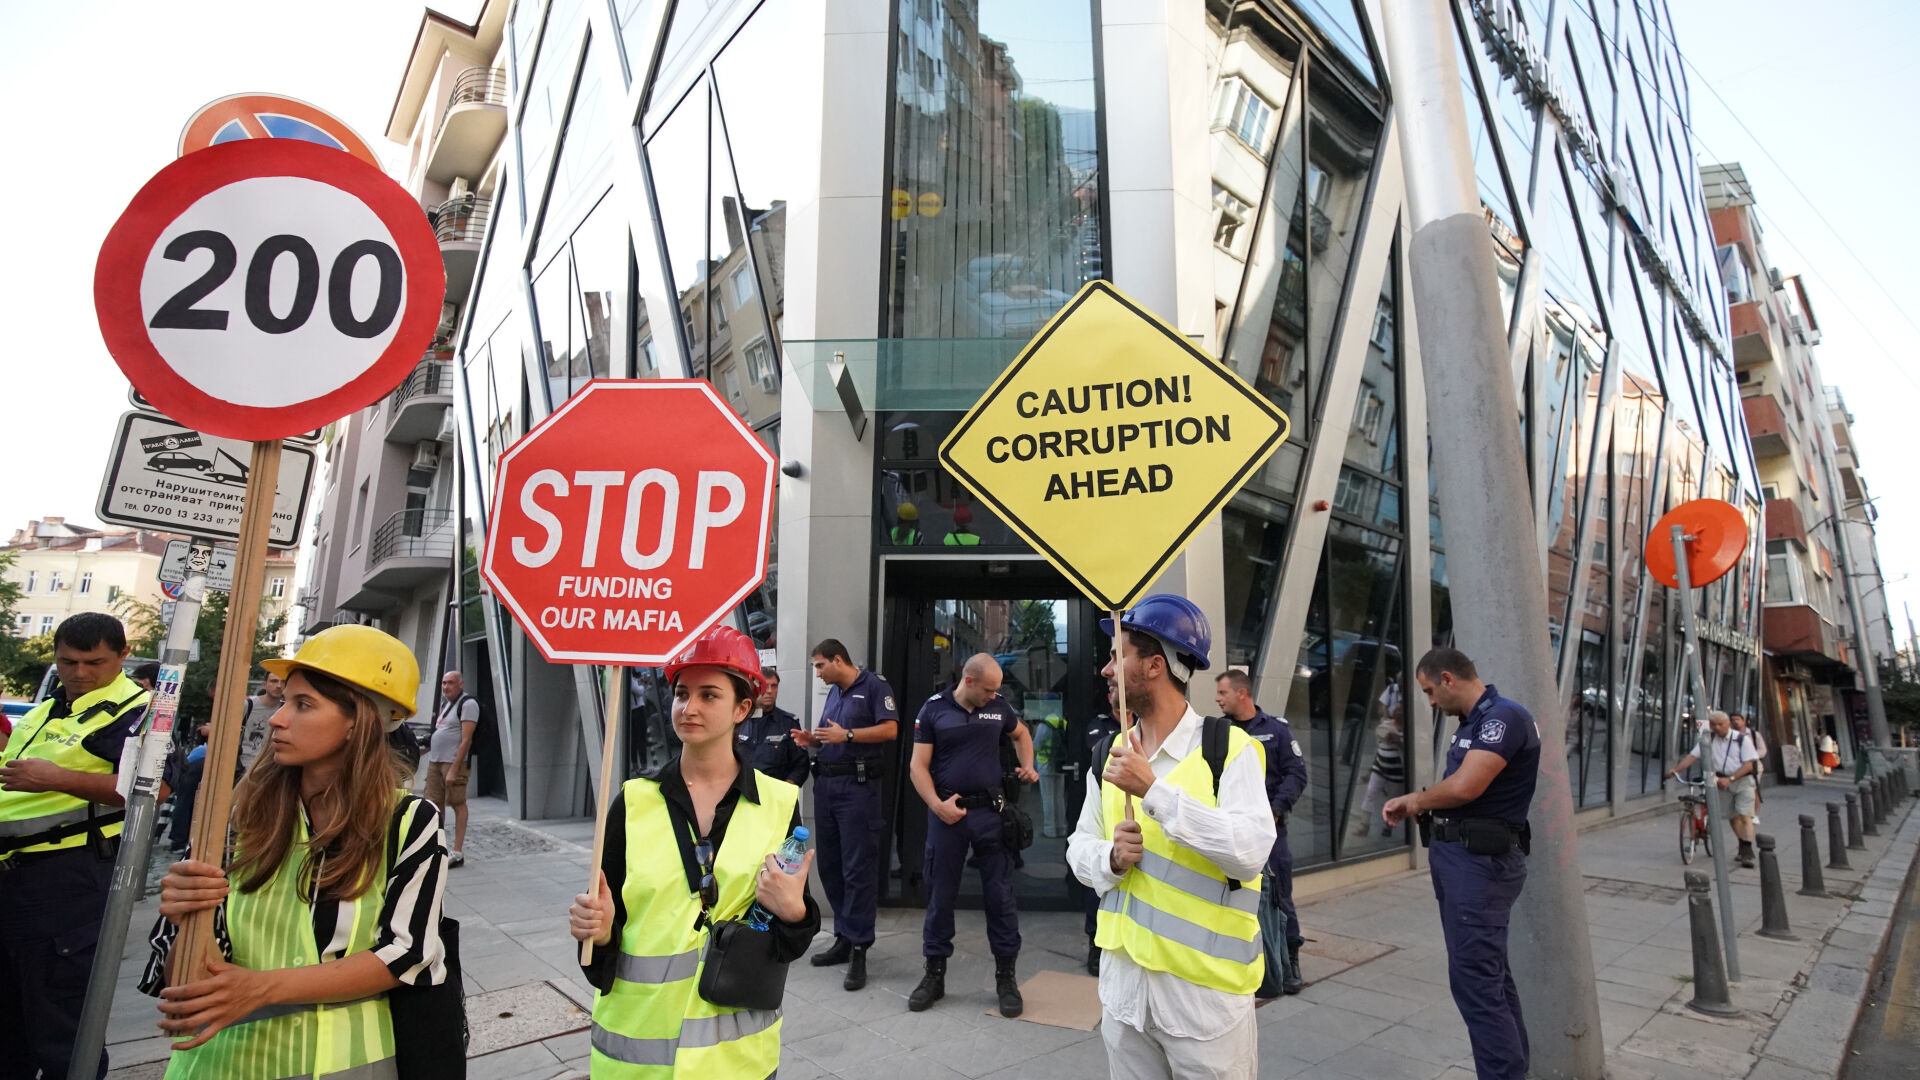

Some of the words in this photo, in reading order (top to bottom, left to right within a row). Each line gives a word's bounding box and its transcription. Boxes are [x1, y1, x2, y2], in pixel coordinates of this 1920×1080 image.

[149, 230, 403, 338] 200
[1016, 374, 1192, 419] CAUTION!
[986, 414, 1232, 464] CORRUPTION
[120, 485, 204, 506] отстраняват
[155, 479, 246, 503] Нарушителите
[1043, 463, 1173, 502] AHEAD
[143, 504, 173, 516] 0700
[177, 509, 188, 518] 13
[193, 512, 213, 523] 233
[511, 468, 746, 571] STOP
[558, 575, 673, 600] FUNDING
[540, 606, 596, 630] OUR
[602, 608, 684, 633] MAFIA
[978, 713, 1002, 721] POLICE
